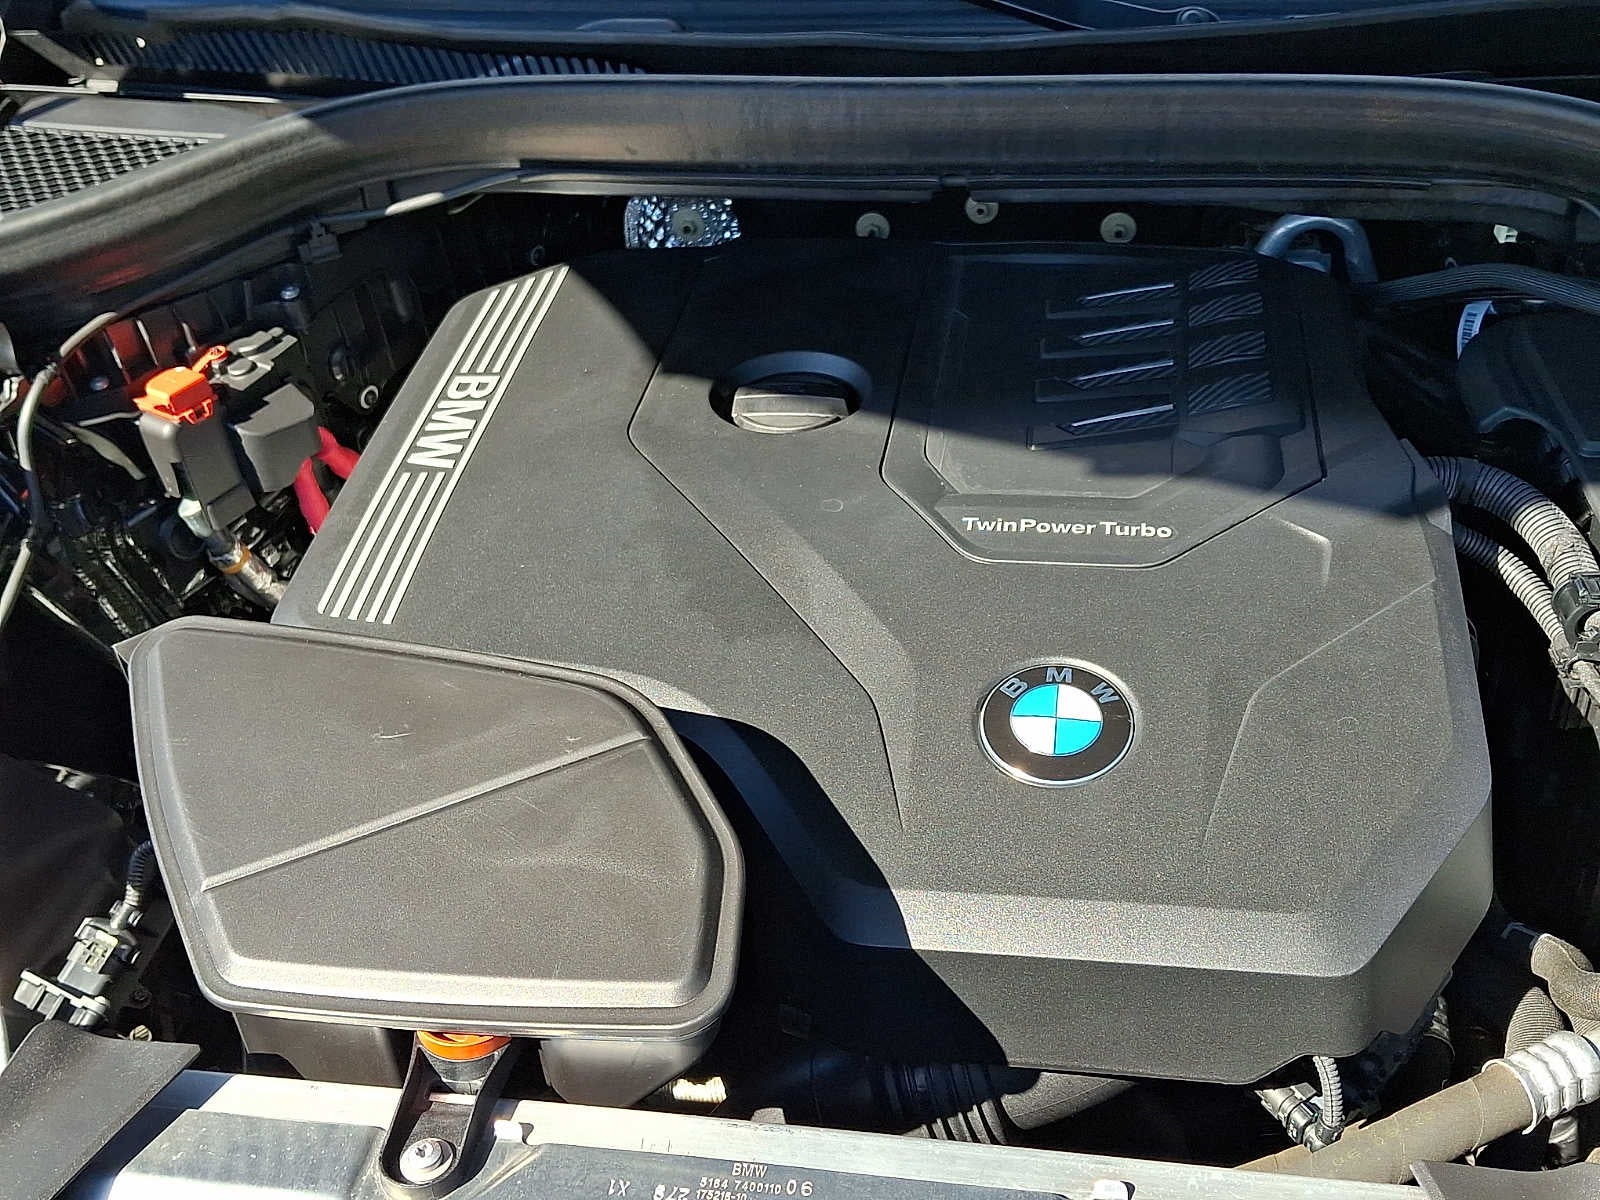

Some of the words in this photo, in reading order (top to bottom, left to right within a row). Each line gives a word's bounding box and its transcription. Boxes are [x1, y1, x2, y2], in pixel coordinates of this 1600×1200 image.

[406, 375, 501, 470] BMW
[1100, 520, 1173, 538] Turbo
[1000, 667, 1121, 704] BMW
[732, 1162, 768, 1178] BMW
[735, 1180, 781, 1195] 7400110
